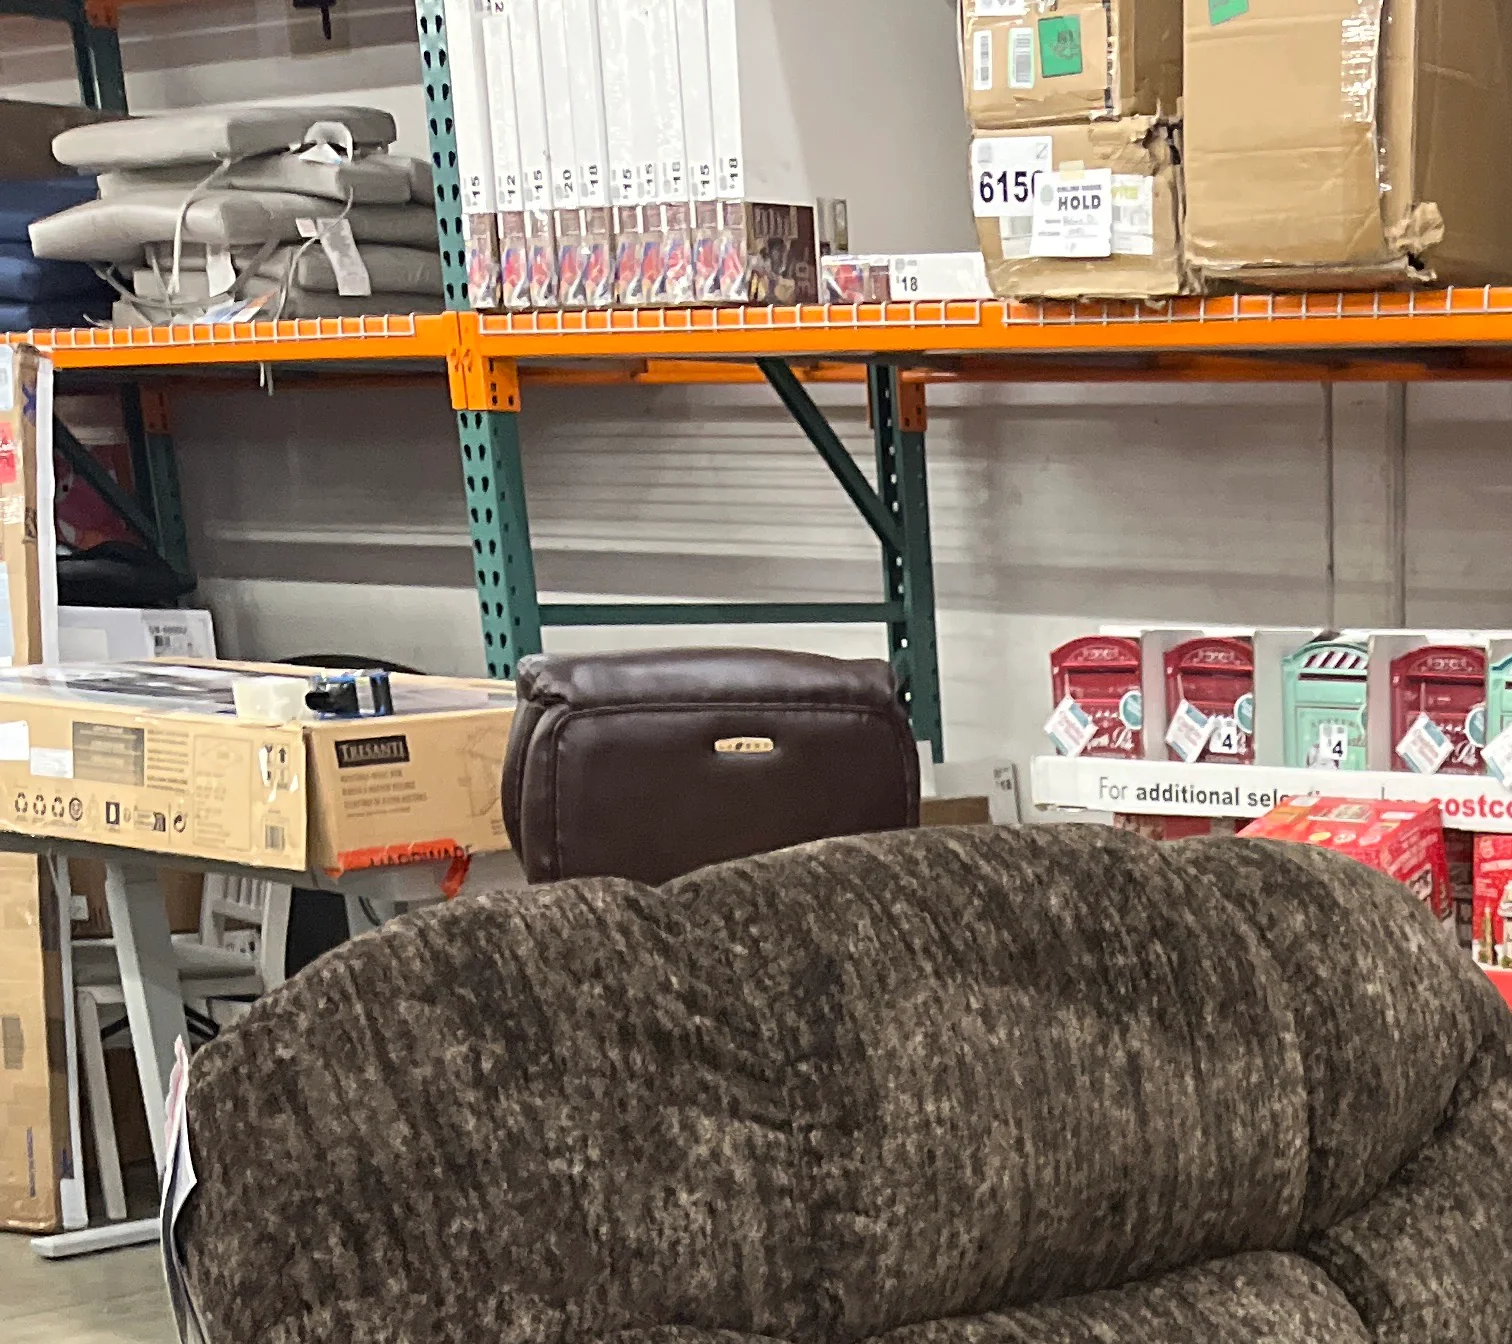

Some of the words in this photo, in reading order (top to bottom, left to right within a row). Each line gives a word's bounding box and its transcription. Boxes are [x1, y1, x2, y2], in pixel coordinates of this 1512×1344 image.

[1057, 193, 1102, 211] HOLD
[1099, 776, 1129, 802] For
[1136, 783, 1240, 808] additional
